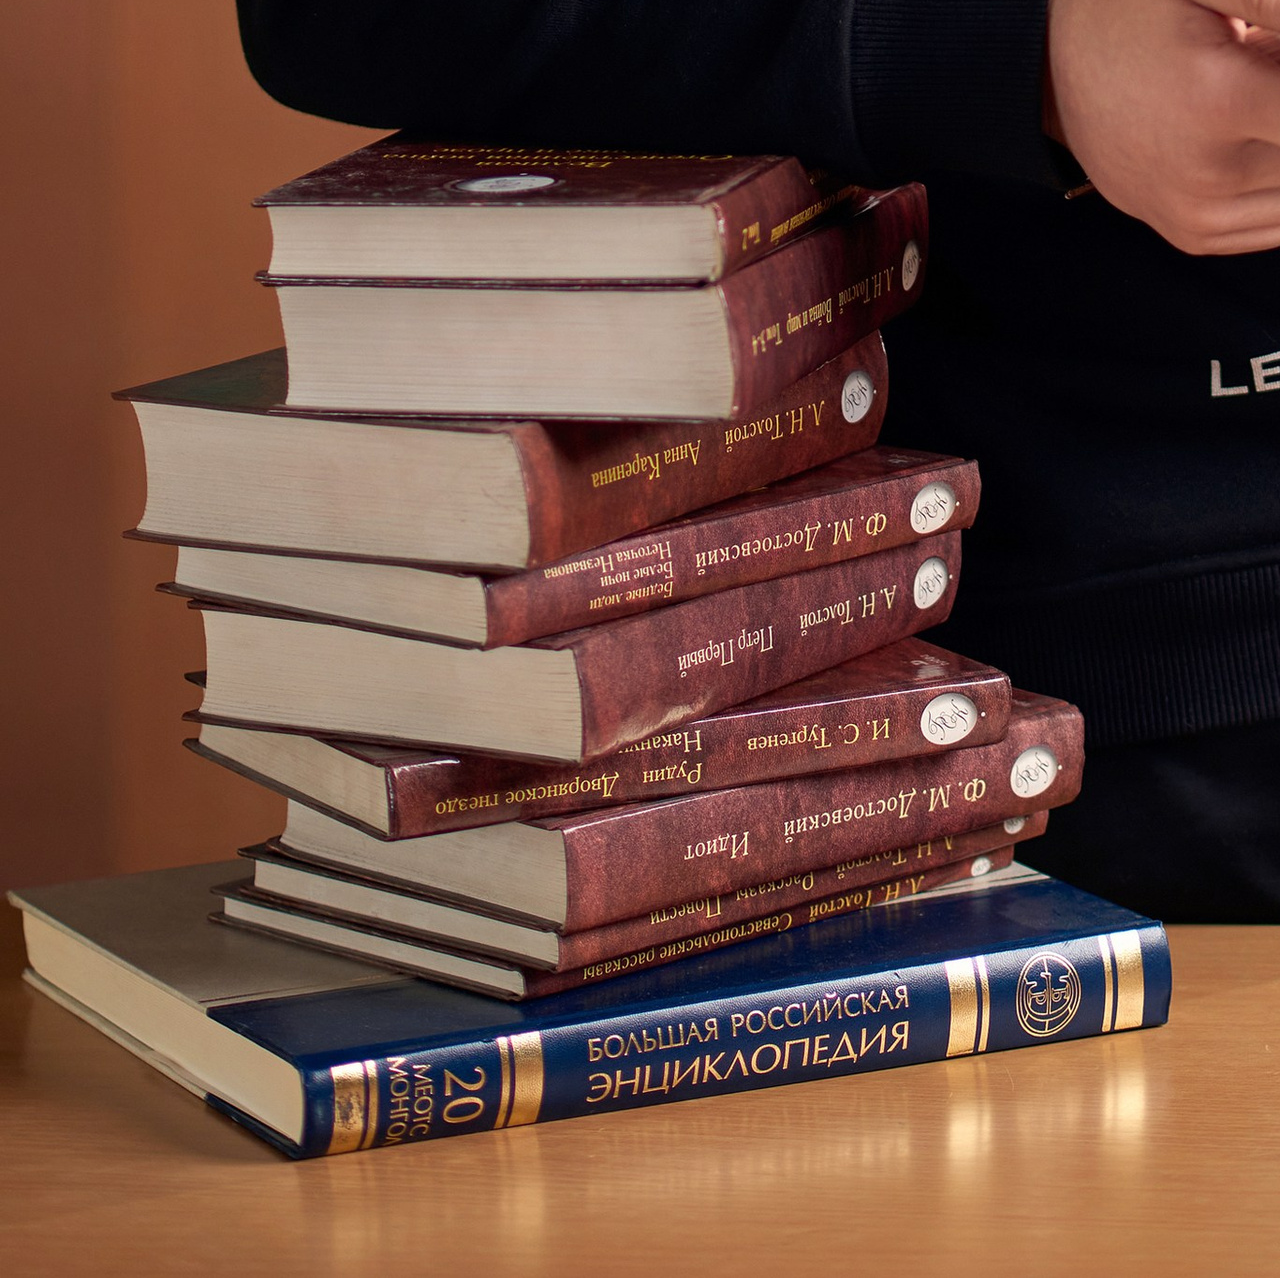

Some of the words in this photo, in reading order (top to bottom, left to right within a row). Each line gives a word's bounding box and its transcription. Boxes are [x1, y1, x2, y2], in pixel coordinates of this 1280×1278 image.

[838, 278, 870, 315] Толстой
[809, 297, 832, 326] Война
[785, 406, 804, 435] Н.
[807, 399, 825, 426] Л.
[724, 413, 783, 453] Толстой
[663, 439, 702, 466] Анна
[590, 452, 660, 489] Каренина
[827, 517, 854, 546] М.
[860, 512, 888, 537] Ф.
[615, 541, 673, 563] Неточка
[695, 521, 822, 576] Достоевский
[542, 552, 615, 581] Незванова
[599, 571, 632, 590] ночи
[633, 560, 674, 581] Белые
[588, 590, 623, 611] люди
[624, 580, 674, 602] Бедные
[857, 591, 876, 618] Н.
[879, 584, 897, 609] А.
[799, 599, 854, 637] Толстой
[737, 625, 775, 652] Петр
[677, 639, 734, 678] Первый
[746, 722, 833, 753] Тургенев
[837, 723, 862, 745] С.
[863, 718, 891, 741] И.
[642, 761, 703, 786] Рудин
[434, 791, 500, 816] гнездо
[504, 772, 620, 809] Дворянское
[922, 783, 952, 812] М.
[958, 777, 987, 802] Ф.
[783, 786, 917, 843] Достоевский
[683, 830, 750, 861] Идиот
[879, 880, 901, 901] Н.
[905, 874, 925, 893] Л.
[649, 895, 722, 926] Повести
[808, 889, 873, 923] Толстой
[659, 911, 793, 961] Севастопольские
[582, 944, 656, 981] рассказы
[587, 1017, 719, 1062] БОЛЬШАЯ
[730, 984, 910, 1039] РОССИЙСКАЯ
[585, 1019, 910, 1104] ЭНЦИКЛОПЕДИЯ
[409, 1063, 434, 1137] МЕОТС
[442, 1066, 487, 1124] 20
